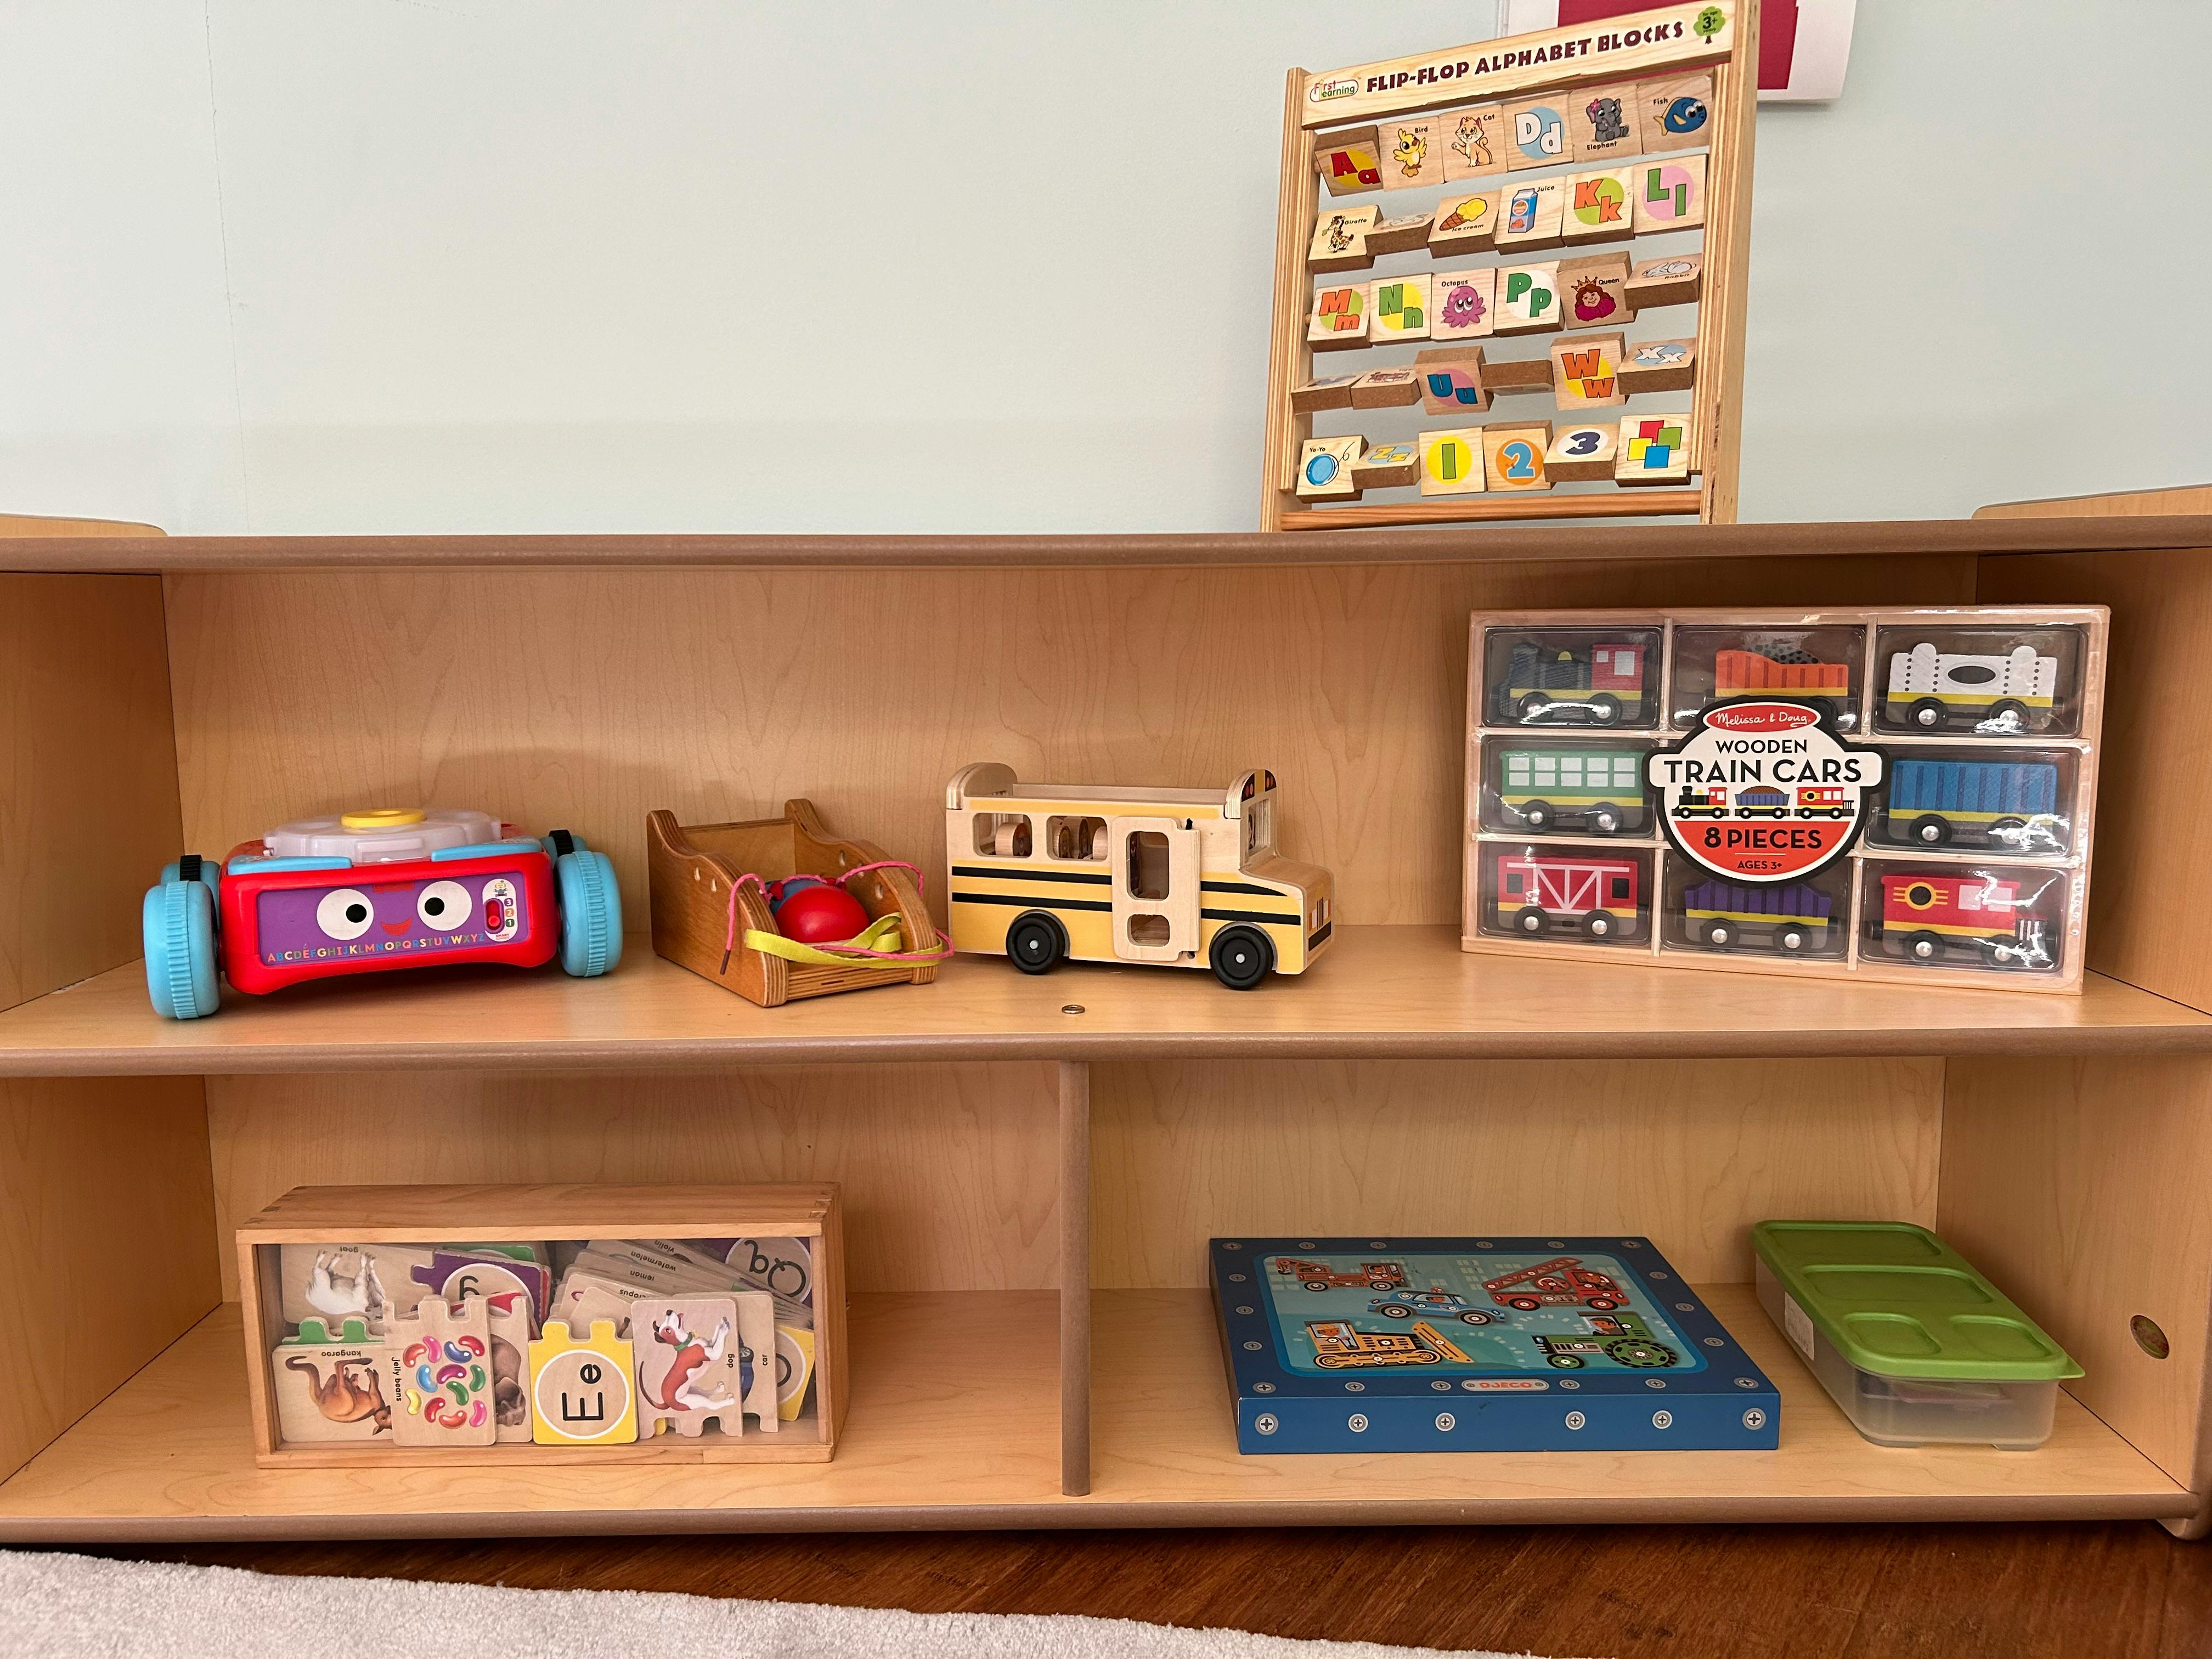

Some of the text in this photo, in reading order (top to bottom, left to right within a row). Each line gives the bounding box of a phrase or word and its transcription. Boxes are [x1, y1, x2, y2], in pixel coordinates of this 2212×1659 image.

[1702, 16, 1718, 29] 3+
[1367, 21, 1683, 93] FLIP-FLOP ALPHABET BLOCKS
[1653, 98, 1668, 106] Fish
[1414, 126, 1429, 134] Bird
[1515, 112, 1563, 155] Dd
[1587, 140, 1618, 150] Elephant
[1330, 151, 1381, 184] Aa
[1537, 184, 1555, 193] Juice
[1573, 179, 1622, 223] Kk
[1441, 279, 1469, 287] Octopus
[1598, 277, 1620, 285] Queen
[1506, 272, 1553, 318] Pp
[1318, 288, 1361, 332] Mm
[1379, 284, 1424, 329] Nn
[1632, 346, 1687, 364] Xx
[1560, 348, 1615, 399] Ww
[1427, 374, 1478, 405] Uu
[1565, 431, 1601, 455] 3
[1369, 447, 1409, 462] Zz
[1503, 441, 1535, 479] 2
[1715, 711, 1807, 727] Melissa & Doug
[1715, 739, 1807, 754] WOODEN
[1664, 759, 1861, 783] TRAIN CARS
[1704, 826, 1822, 849] 8 PIECES
[1737, 860, 1782, 870] AGES 3+
[654, 1240, 674, 1252] violin
[631, 1250, 676, 1271] watermelon
[321, 1349, 362, 1358] kangaroo
[726, 1353, 735, 1368] dog
[391, 1357, 402, 1402] jelly beans
